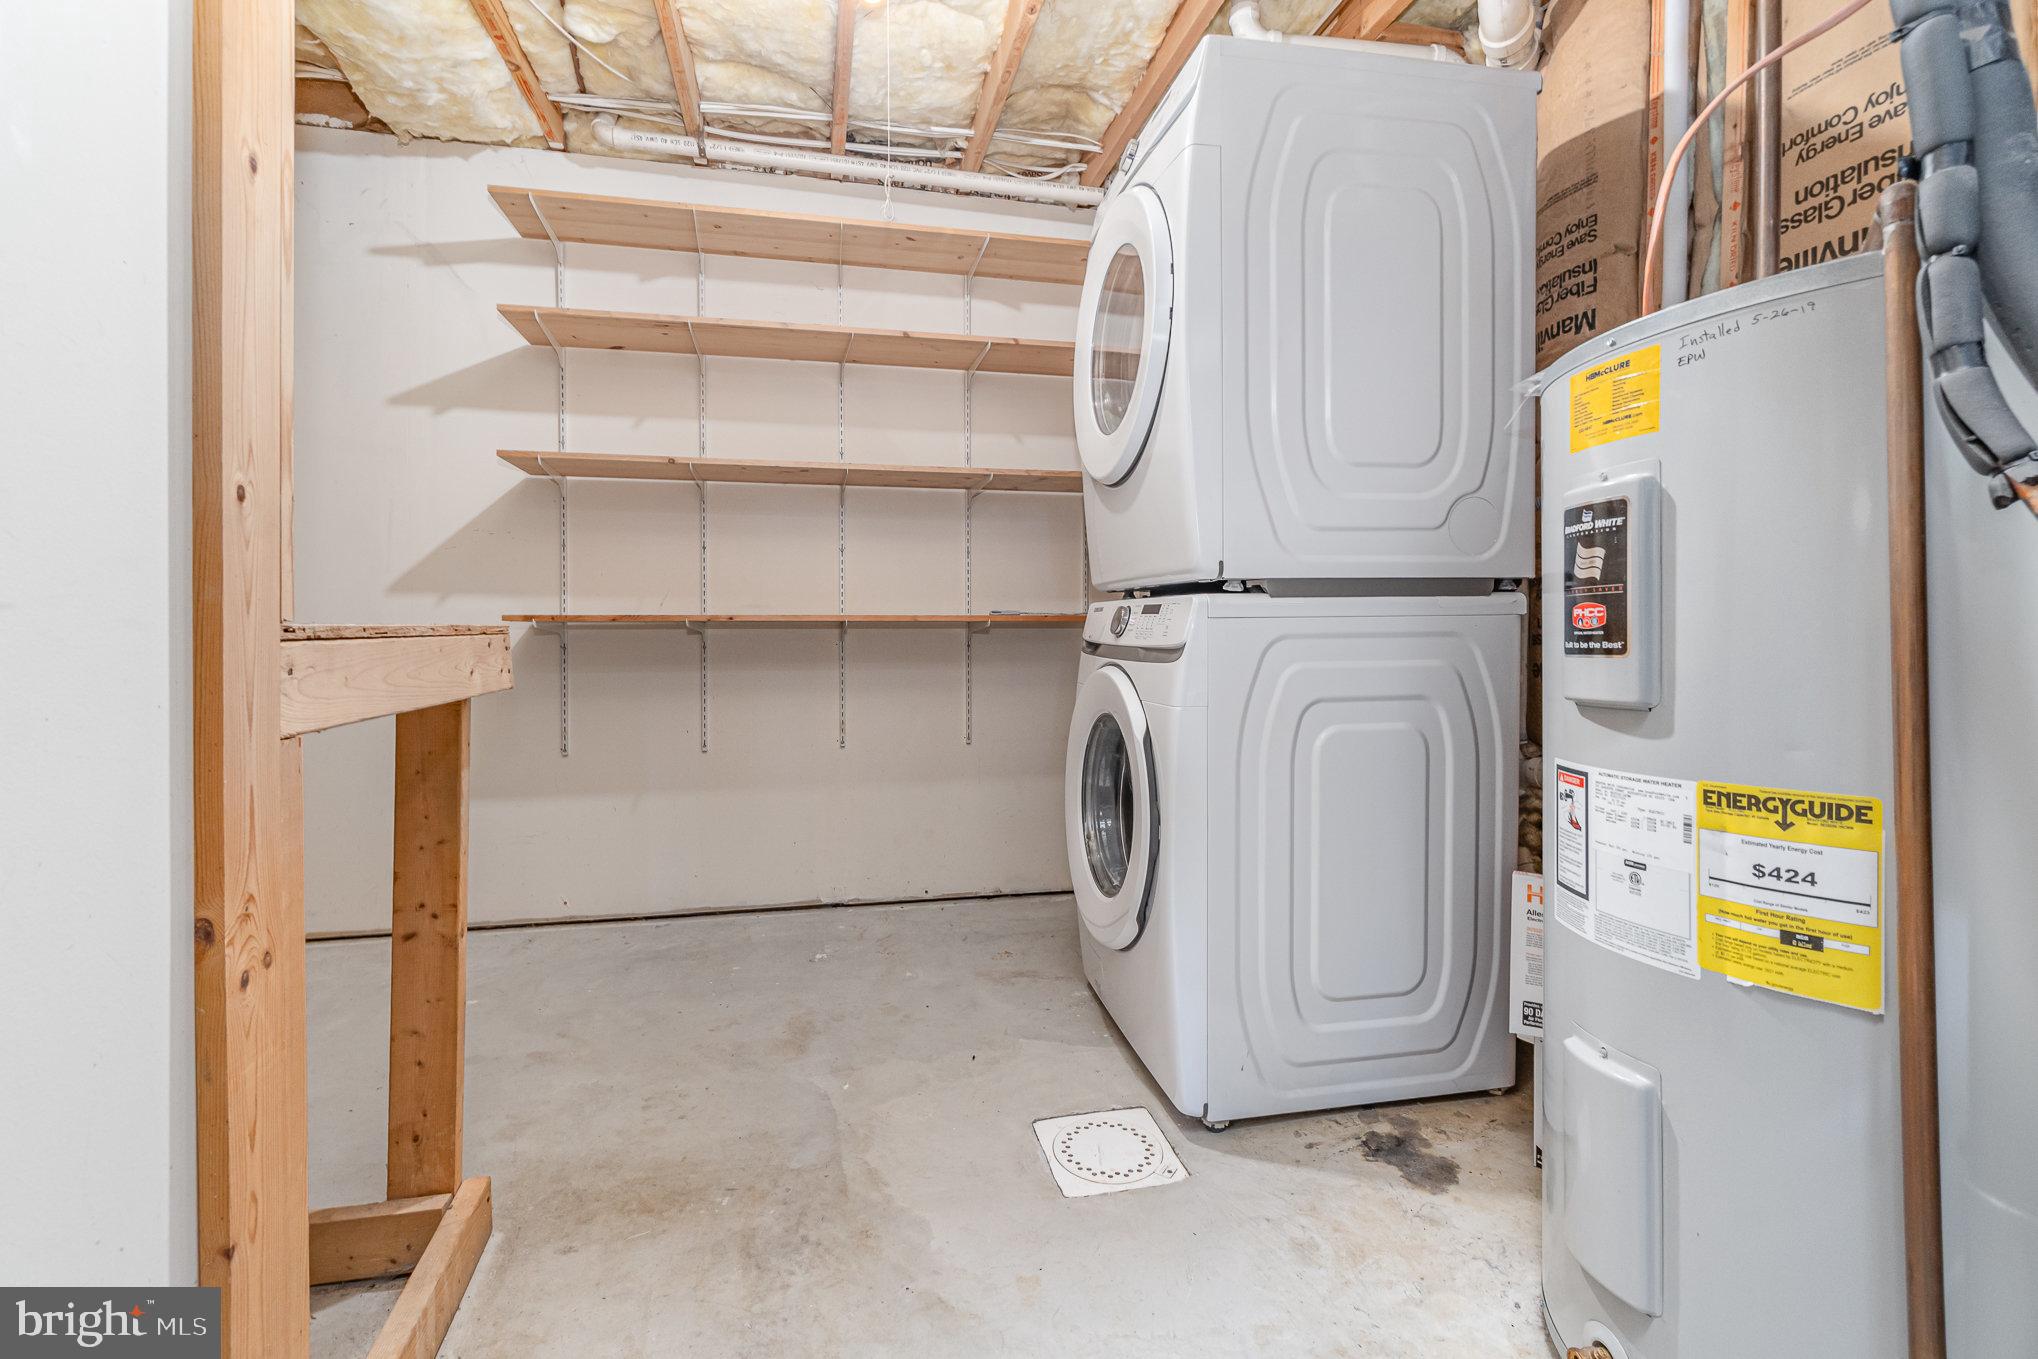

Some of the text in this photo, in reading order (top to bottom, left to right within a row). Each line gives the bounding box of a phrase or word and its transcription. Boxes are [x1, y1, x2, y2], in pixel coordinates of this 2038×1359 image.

[1864, 82, 1907, 112] njoy
[1796, 102, 1907, 167] ave Energy
[1795, 144, 1913, 205] nsulation
[1564, 213, 1598, 238] Enjoy
[1566, 228, 1598, 250] Save
[1679, 301, 1816, 349] Installed 5-26-19
[1677, 349, 1706, 367] EPW
[1594, 517, 1625, 529] WHITE
[1574, 608, 1604, 617] PHCC
[1580, 640, 1588, 649] be
[1589, 641, 1601, 649] the
[1602, 641, 1623, 649] Best
[1621, 775, 1641, 784] STORAGE
[1703, 788, 1873, 826] ENERGYGUIDE
[1741, 839, 1823, 856] Estimated Yearly Energy Cost
[1752, 863, 1818, 887] $424
[1755, 909, 1769, 917] First
[1785, 915, 1806, 924] Rating
[1524, 1006, 1534, 1015] 90
